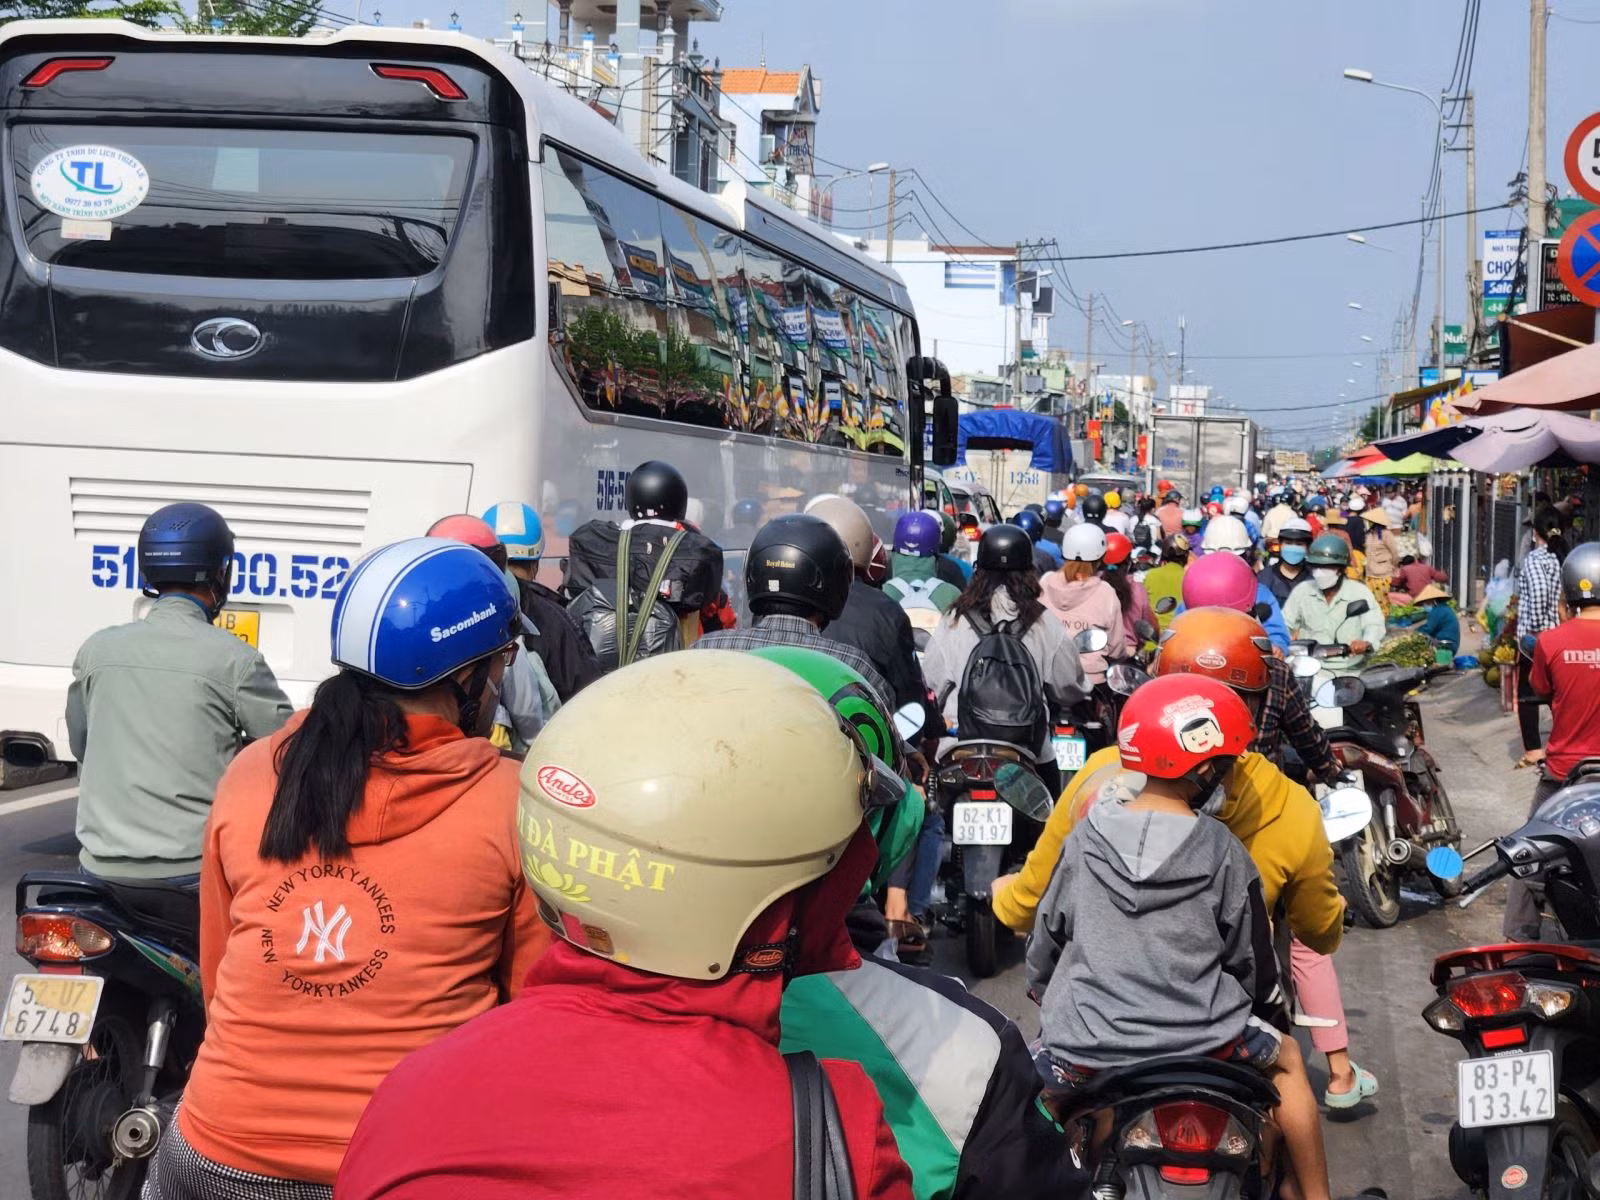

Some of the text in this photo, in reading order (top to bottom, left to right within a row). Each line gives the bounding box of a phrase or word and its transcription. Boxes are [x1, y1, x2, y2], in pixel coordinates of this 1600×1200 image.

[70, 161, 114, 190] TL
[430, 602, 497, 643] Sacombank
[963, 806, 1003, 824] 62-K1
[958, 824, 1008, 842] 391.97
[526, 815, 560, 861] ĐÀ
[567, 837, 675, 893] PHẬT
[261, 928, 279, 964] NEW
[14, 1009, 80, 1036] 6748
[1473, 1058, 1537, 1091] 83-P4
[1467, 1087, 1549, 1122] 133.42
